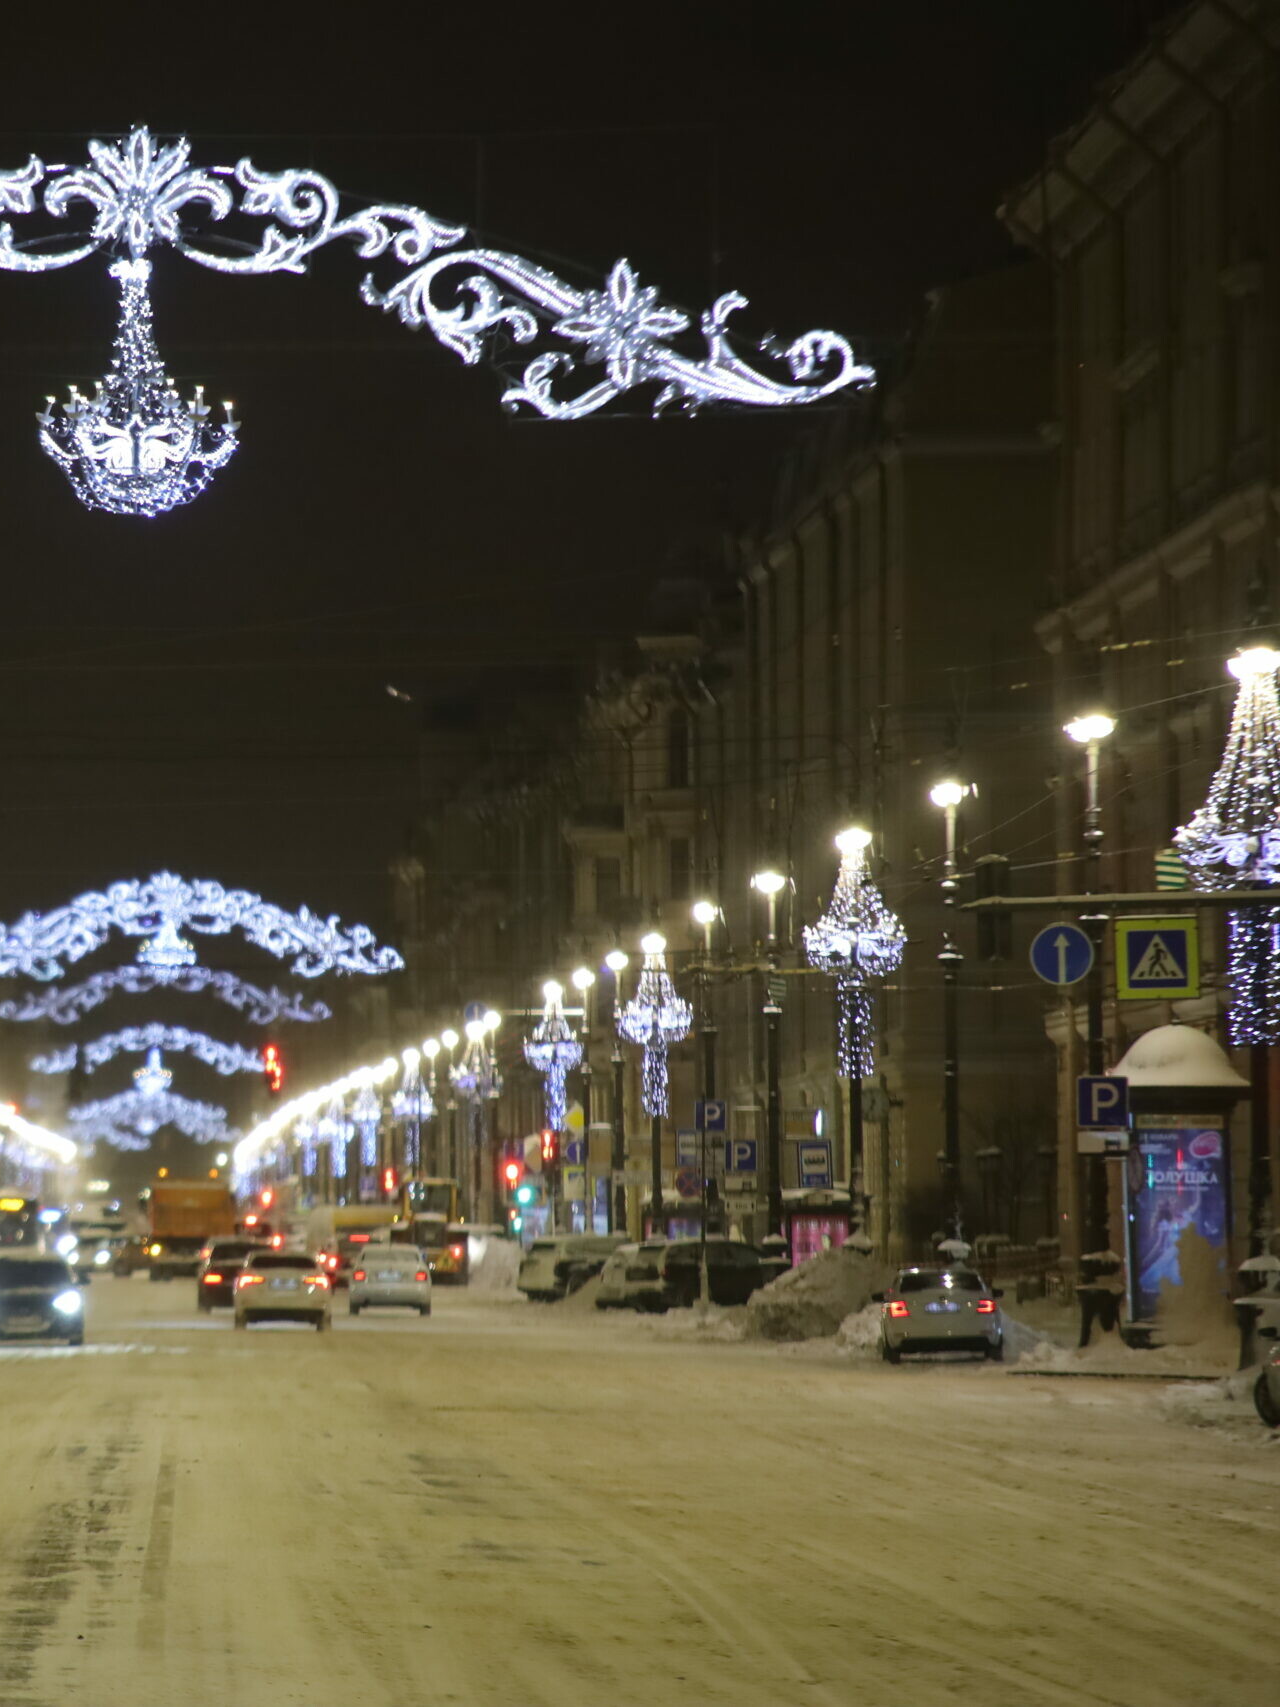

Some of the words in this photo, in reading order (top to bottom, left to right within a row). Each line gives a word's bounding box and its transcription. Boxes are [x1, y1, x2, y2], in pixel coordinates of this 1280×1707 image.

[1091, 1082, 1119, 1122] P
[704, 1103, 721, 1128] P
[734, 1143, 751, 1169] P
